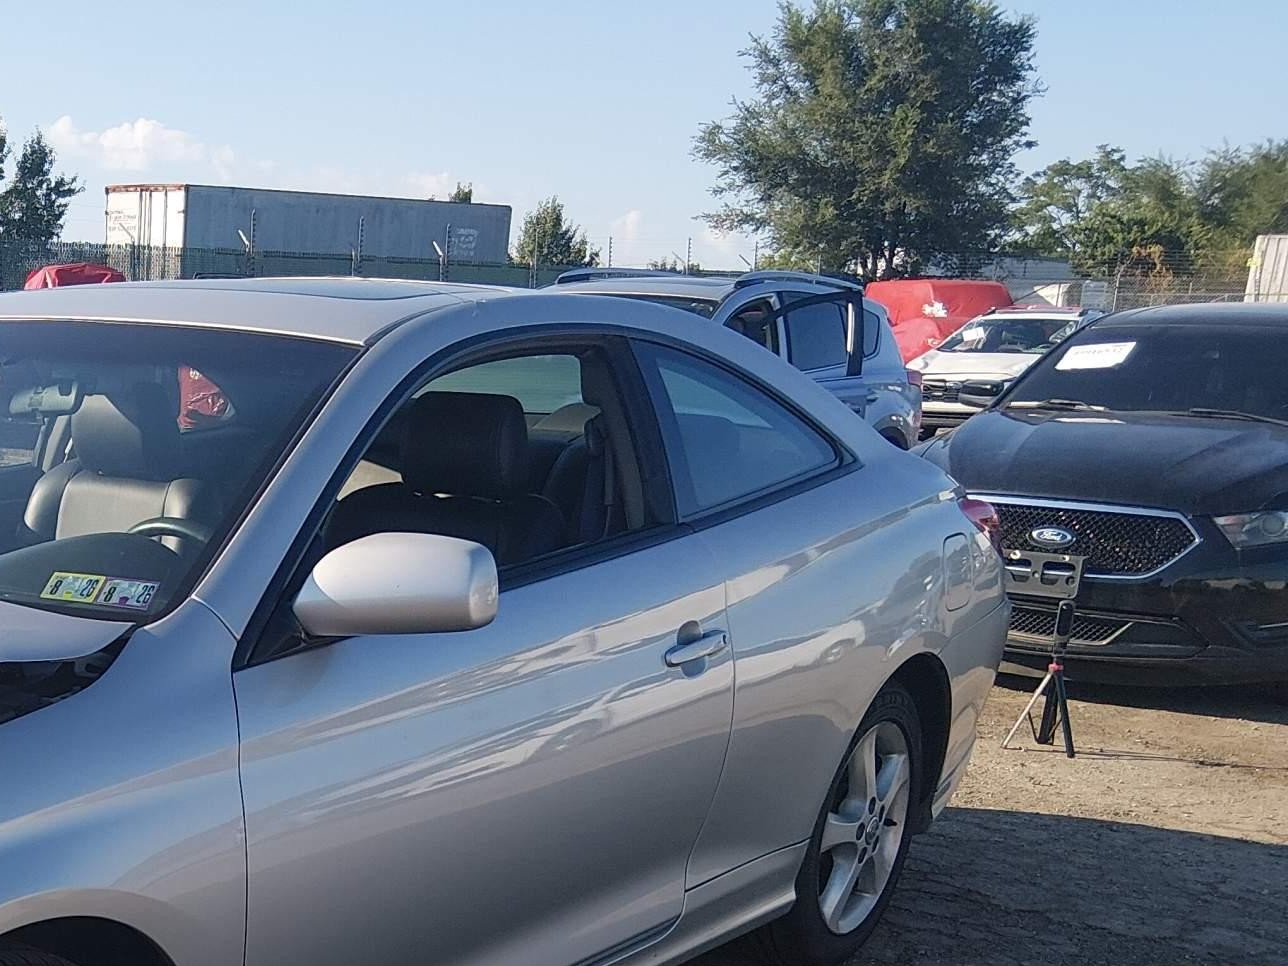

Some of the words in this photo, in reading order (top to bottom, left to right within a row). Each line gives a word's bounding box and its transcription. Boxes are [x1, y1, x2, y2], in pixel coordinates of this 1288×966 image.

[50, 580, 63, 595] 8
[79, 578, 100, 598] 26
[104, 587, 117, 602] 8
[135, 584, 155, 605] 26
